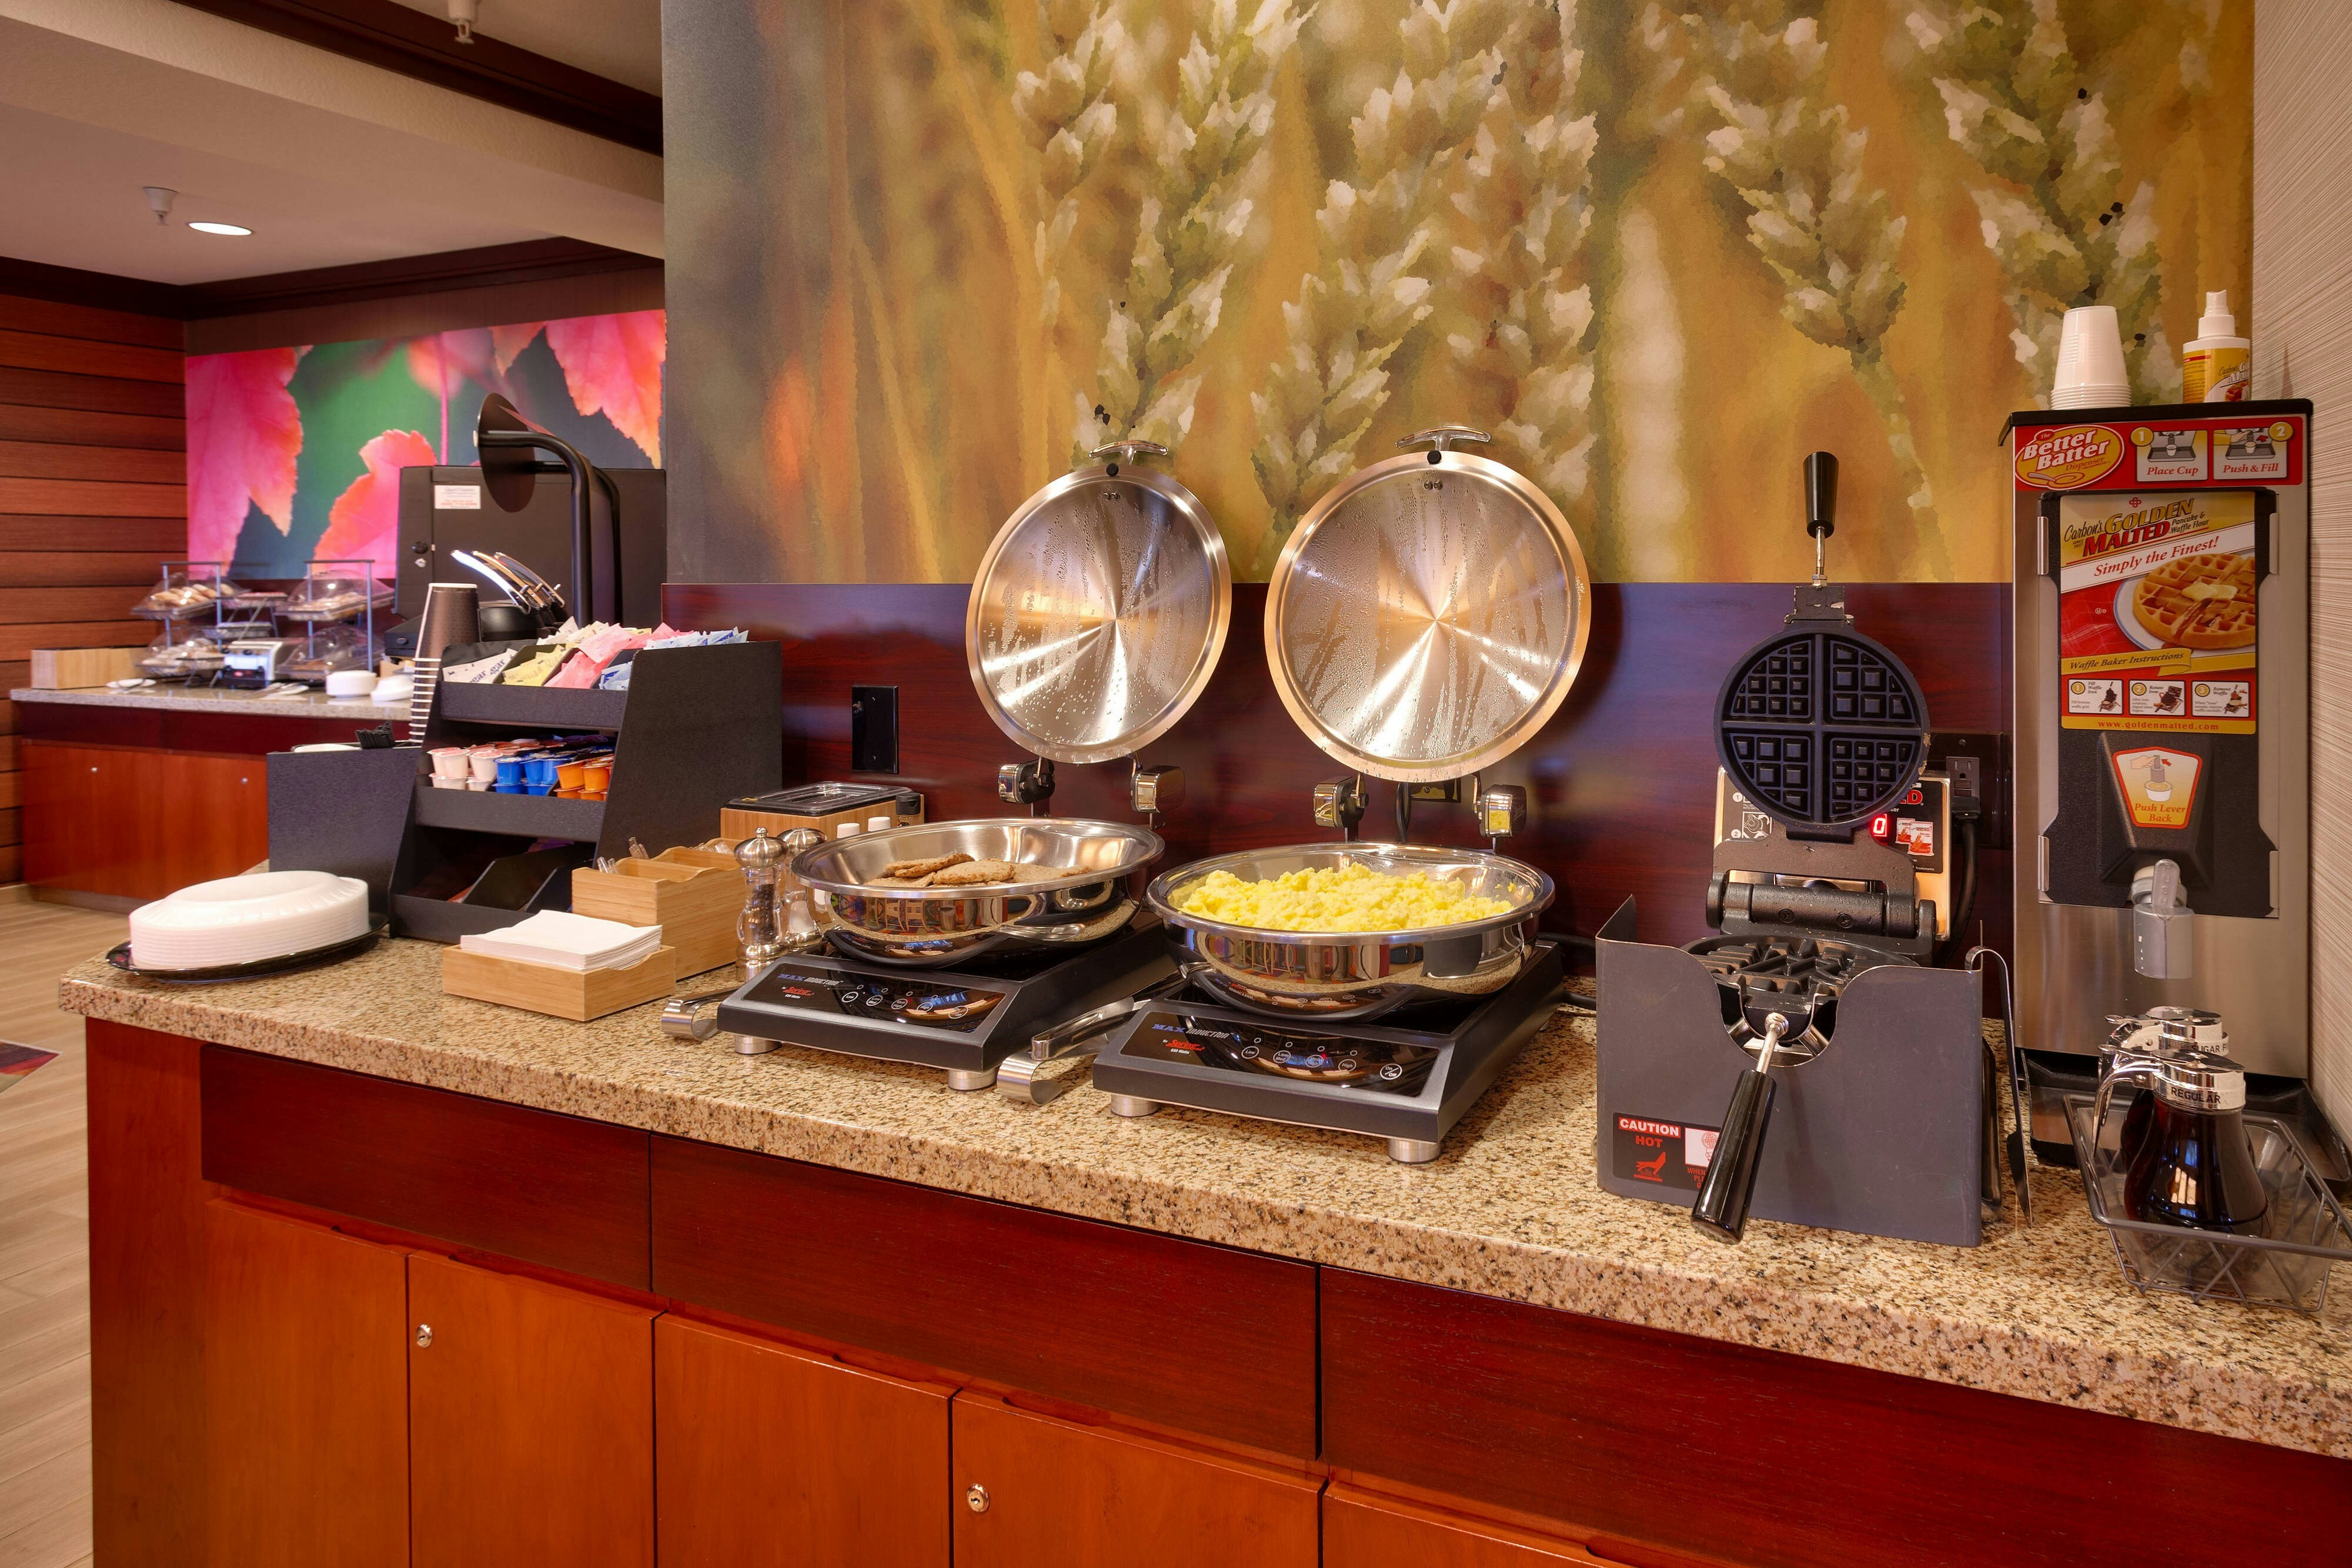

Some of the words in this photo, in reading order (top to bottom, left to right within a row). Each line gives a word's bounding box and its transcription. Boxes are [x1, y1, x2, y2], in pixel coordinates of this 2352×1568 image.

[2138, 431, 2145, 442] 1
[2276, 426, 2286, 437] 2
[2023, 429, 2097, 460] Better
[2037, 440, 2110, 470] Batter
[2066, 457, 2104, 470] Dispenser
[2223, 464, 2249, 473] Push
[2260, 463, 2279, 472] Fill
[2147, 466, 2174, 475] Place
[2177, 466, 2199, 476] Cup
[2104, 498, 2195, 535] GOLDEN
[2172, 514, 2198, 526] Pancake
[2171, 523, 2191, 534] Waffle
[2193, 519, 2210, 529] Flour
[2083, 521, 2170, 557] MALTED
[2094, 556, 2142, 577] Simply
[2146, 550, 2167, 564] the
[2170, 536, 2220, 559] Finest!
[2070, 661, 2099, 670] Waffle
[2101, 657, 2127, 667] Baker
[2129, 651, 2185, 664] Instructions
[2098, 720, 2219, 730] www.goldenmalted.com
[2134, 803, 2157, 813] Push
[2160, 804, 2186, 813] Lever
[2149, 814, 2172, 823] Back
[1152, 1024, 1186, 1033] MAX
[1185, 1028, 1230, 1039] INDUCTION
[2191, 1044, 2220, 1053] SUGAR
[2171, 1086, 2221, 1104] REGULAR
[1619, 1118, 1679, 1136] CAUTION
[1635, 1135, 1663, 1148] HOT
